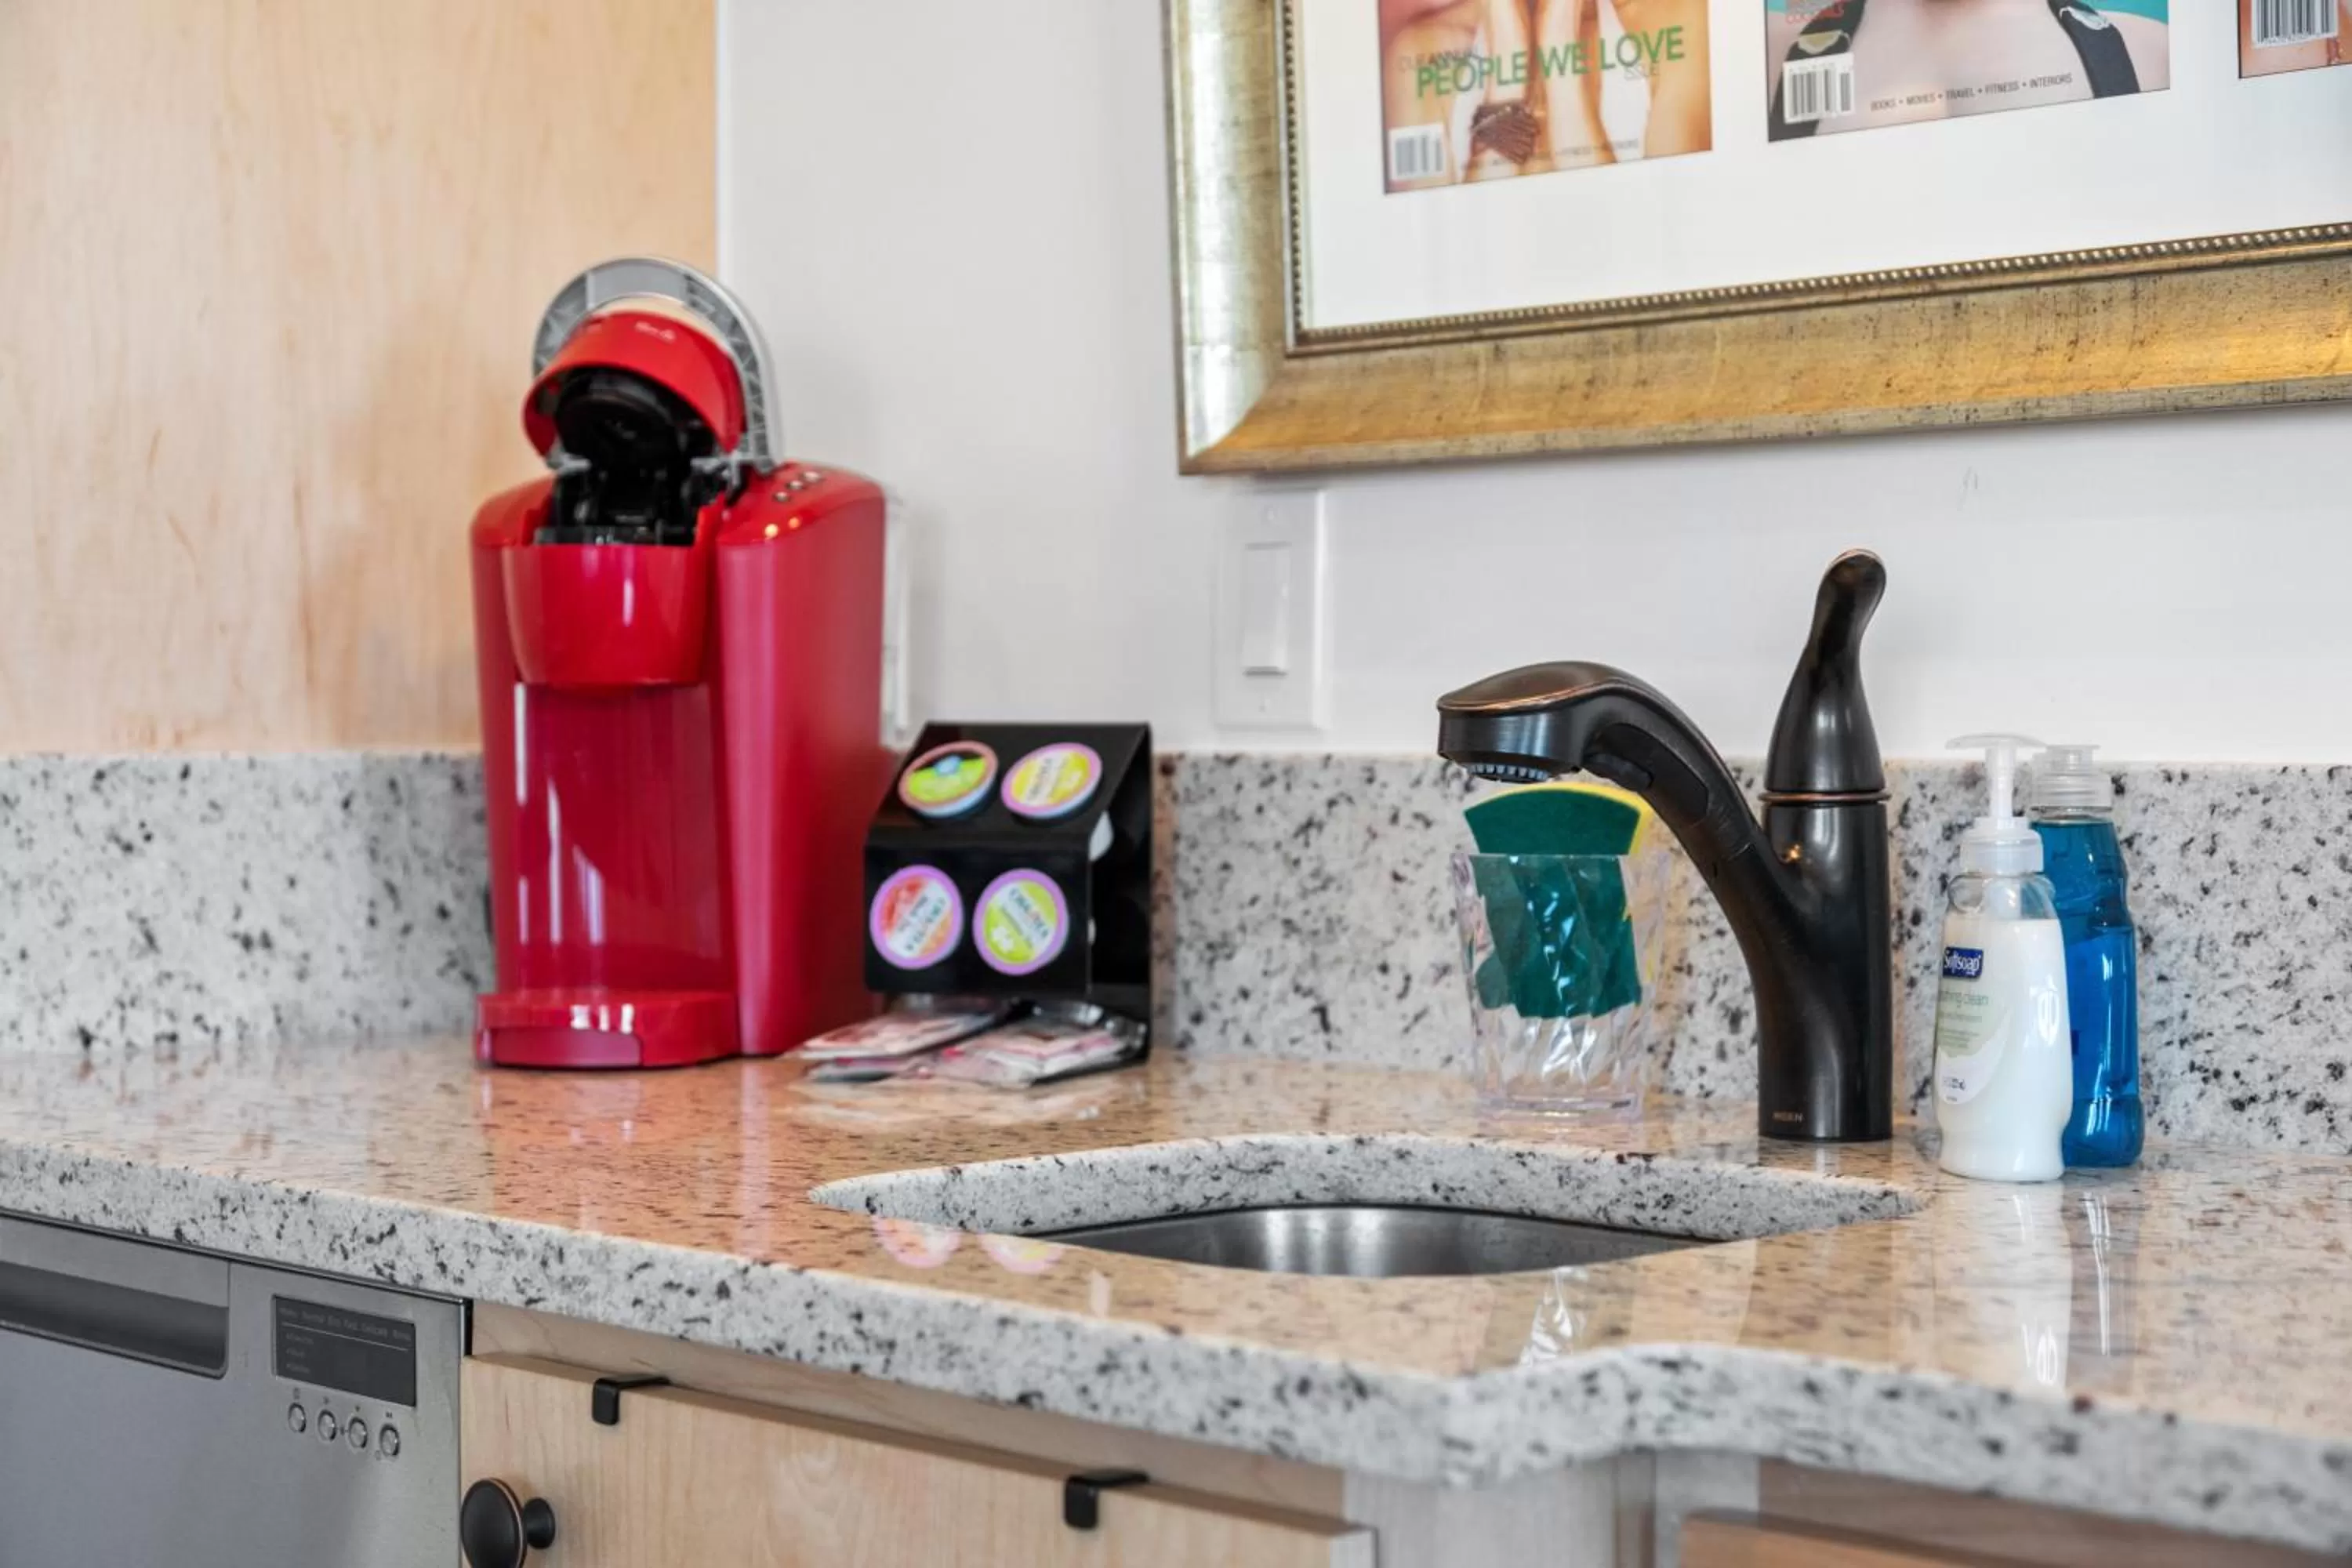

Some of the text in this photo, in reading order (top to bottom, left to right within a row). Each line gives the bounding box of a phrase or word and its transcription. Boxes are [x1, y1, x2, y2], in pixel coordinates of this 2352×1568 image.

[1417, 51, 1528, 99] PEOPLE
[1537, 42, 1588, 77] WE
[1599, 25, 1686, 71] LOVE
[1946, 85, 1975, 101] TRAVEL
[1984, 80, 2020, 96] FITNESS
[2029, 72, 2072, 89] INTERIORS
